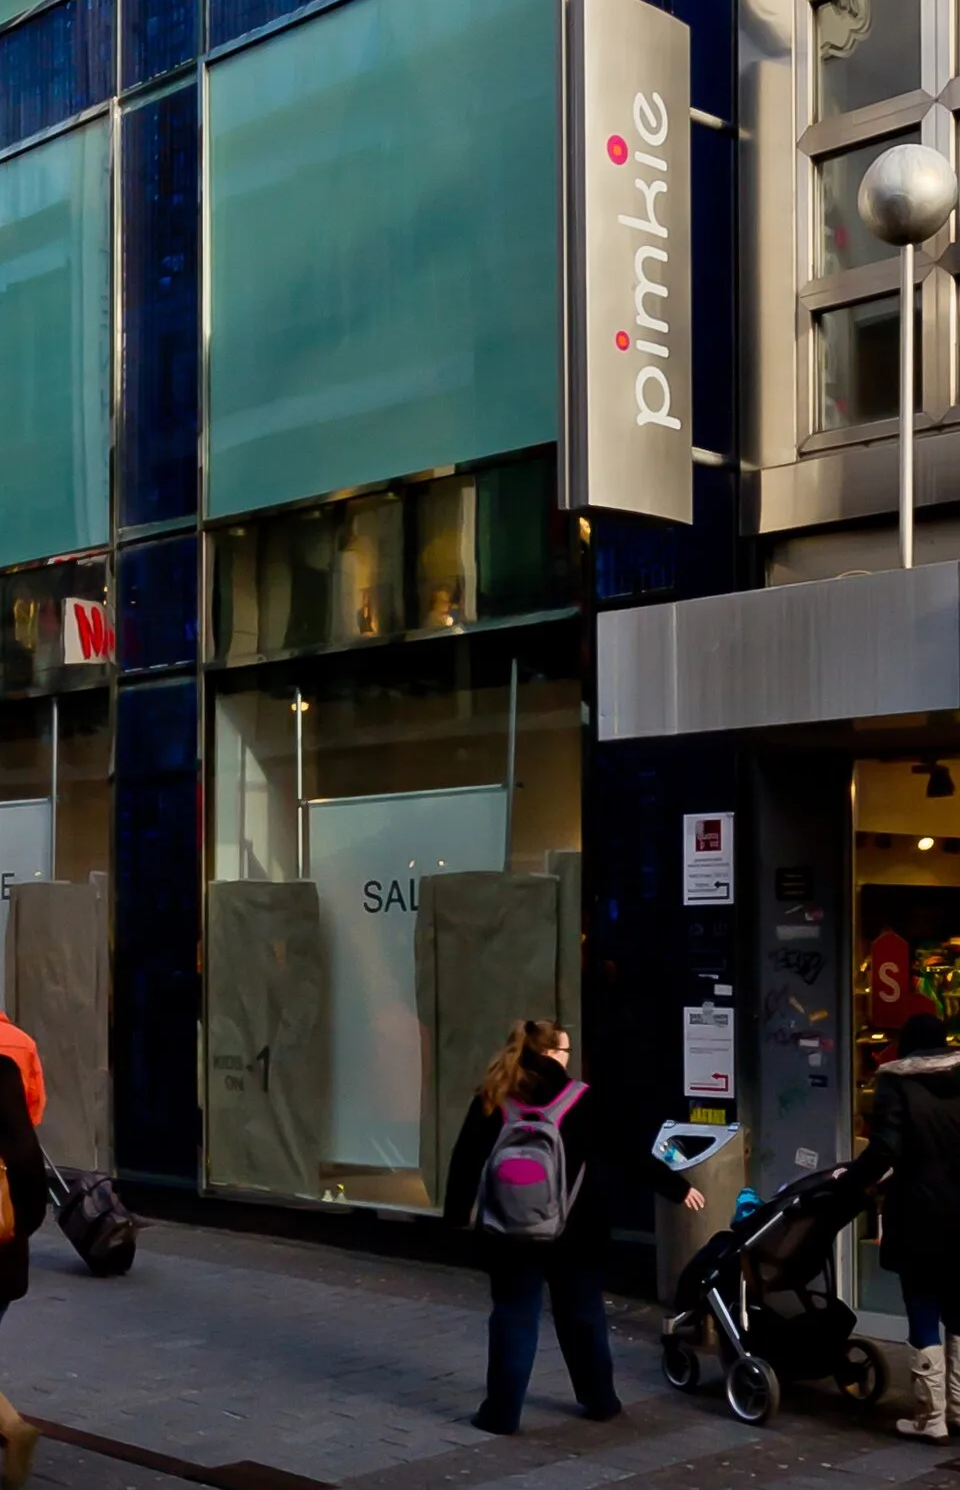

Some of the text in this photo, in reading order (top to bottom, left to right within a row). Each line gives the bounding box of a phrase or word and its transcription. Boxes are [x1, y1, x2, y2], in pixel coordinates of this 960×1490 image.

[606, 91, 682, 431] pimkie
[363, 878, 419, 914] SAL
[878, 961, 901, 1003] S
